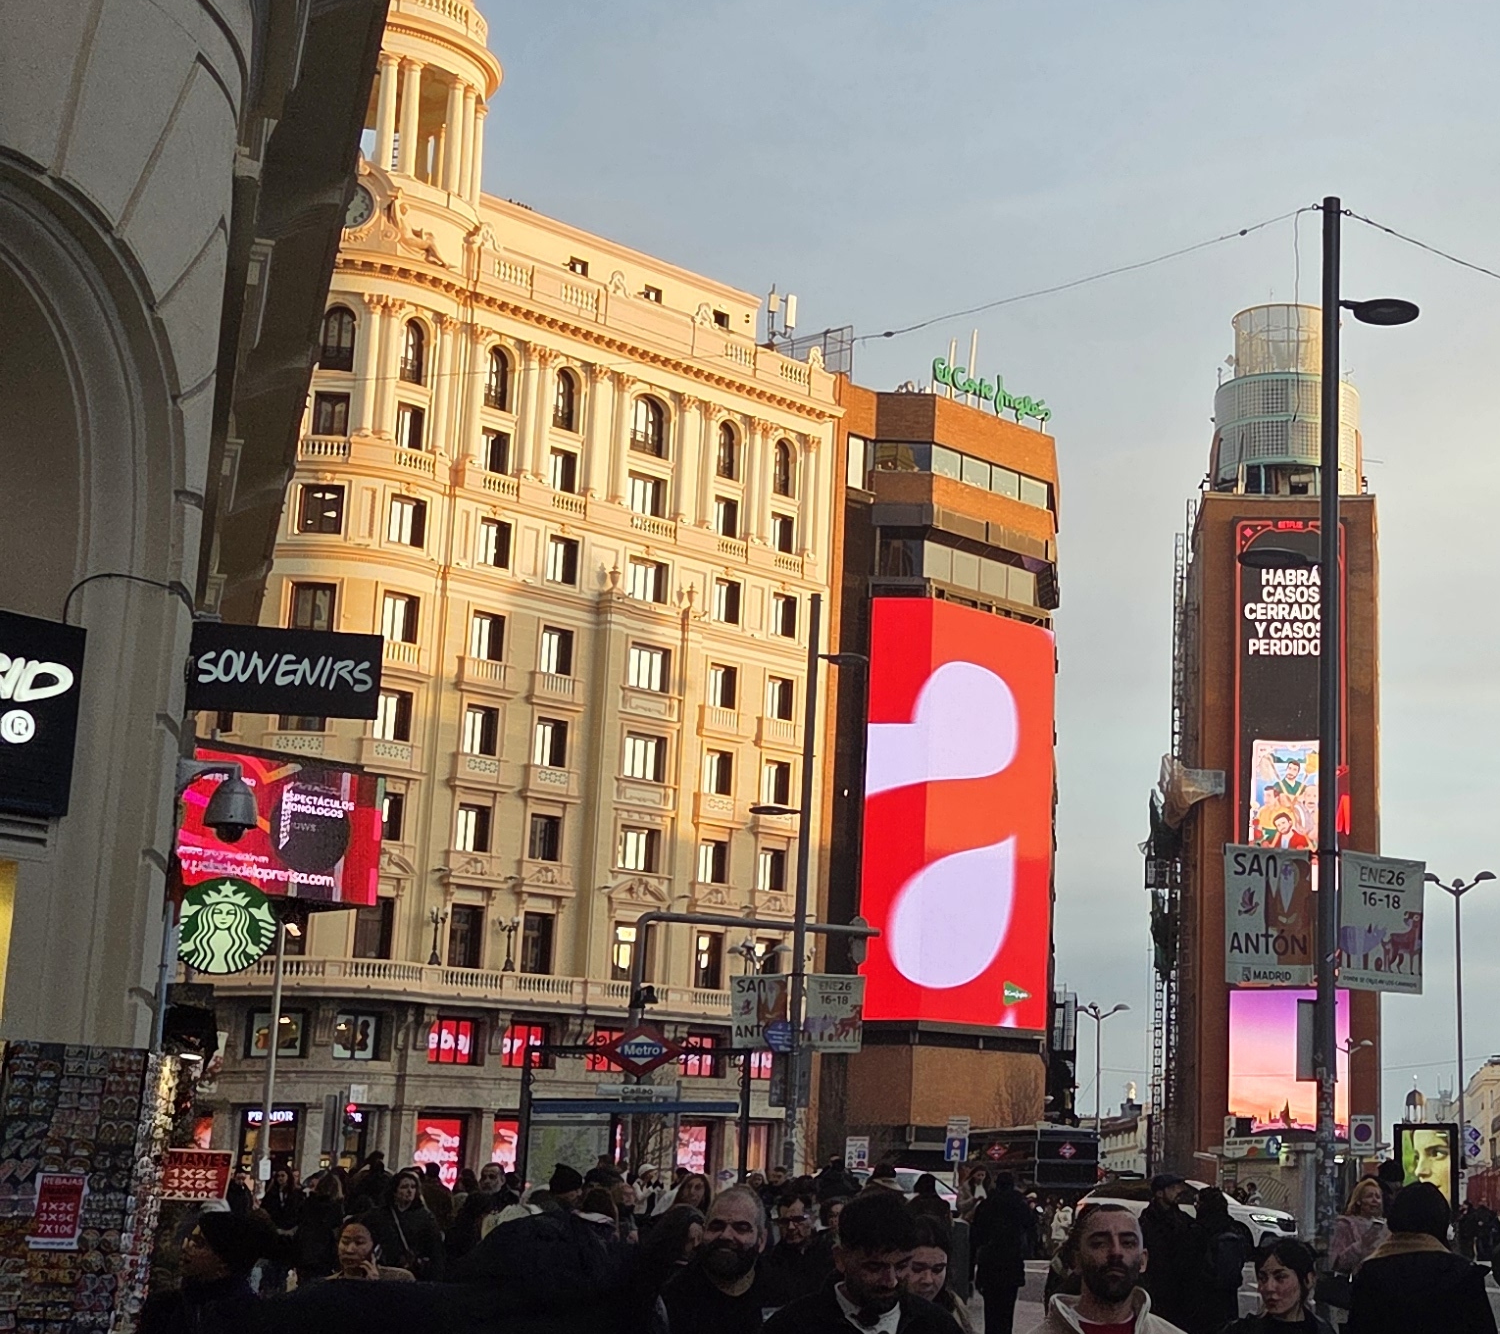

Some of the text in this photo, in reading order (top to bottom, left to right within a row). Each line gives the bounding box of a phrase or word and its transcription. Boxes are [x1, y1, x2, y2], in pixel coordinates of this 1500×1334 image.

[933, 357, 1052, 421] El Corte Inglés
[1261, 565, 1321, 586] HABRÁ
[1262, 586, 1320, 603] CASOS
[1244, 603, 1321, 620] CERRADO
[1254, 621, 1268, 639] Y
[1248, 638, 1321, 656] PERDIDO
[197, 649, 374, 692] SOUVENIRS
[1360, 866, 1406, 886] ENE26
[1361, 890, 1402, 910] 16-18
[1229, 929, 1308, 957] ANTÓN
[1253, 970, 1292, 982] MADRID
[820, 995, 849, 1006] 16-18
[734, 1024, 763, 1038] ANT
[623, 1043, 660, 1056] Metro
[621, 1086, 654, 1096] Callao
[43, 1176, 83, 1186] REBAJAS
